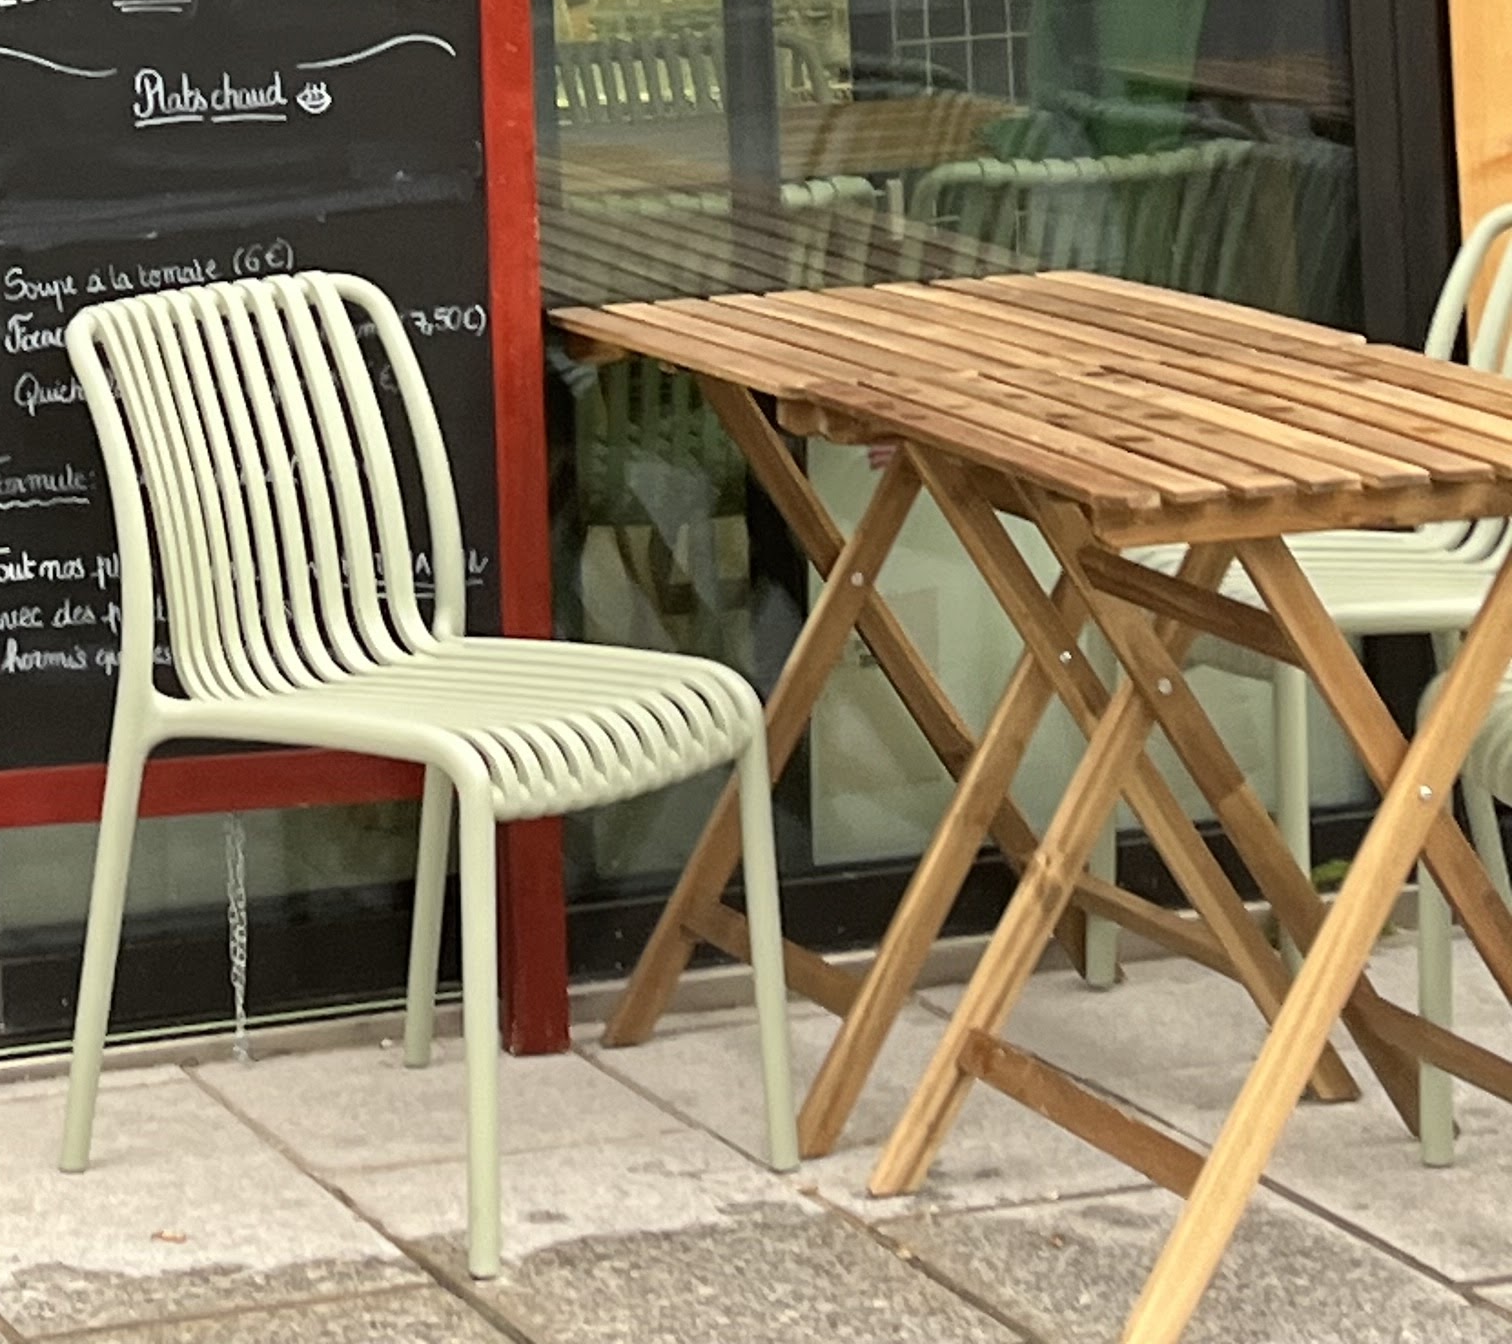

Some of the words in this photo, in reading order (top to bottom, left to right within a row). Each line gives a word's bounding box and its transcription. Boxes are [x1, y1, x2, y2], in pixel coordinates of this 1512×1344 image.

[133, 67, 208, 118] Plats
[210, 70, 289, 111] chaud
[3, 266, 79, 312] Soupe
[107, 263, 134, 292] la
[136, 257, 224, 289] tomate
[13, 371, 88, 417] Quich
[38, 556, 86, 582] nos
[51, 596, 96, 628] des
